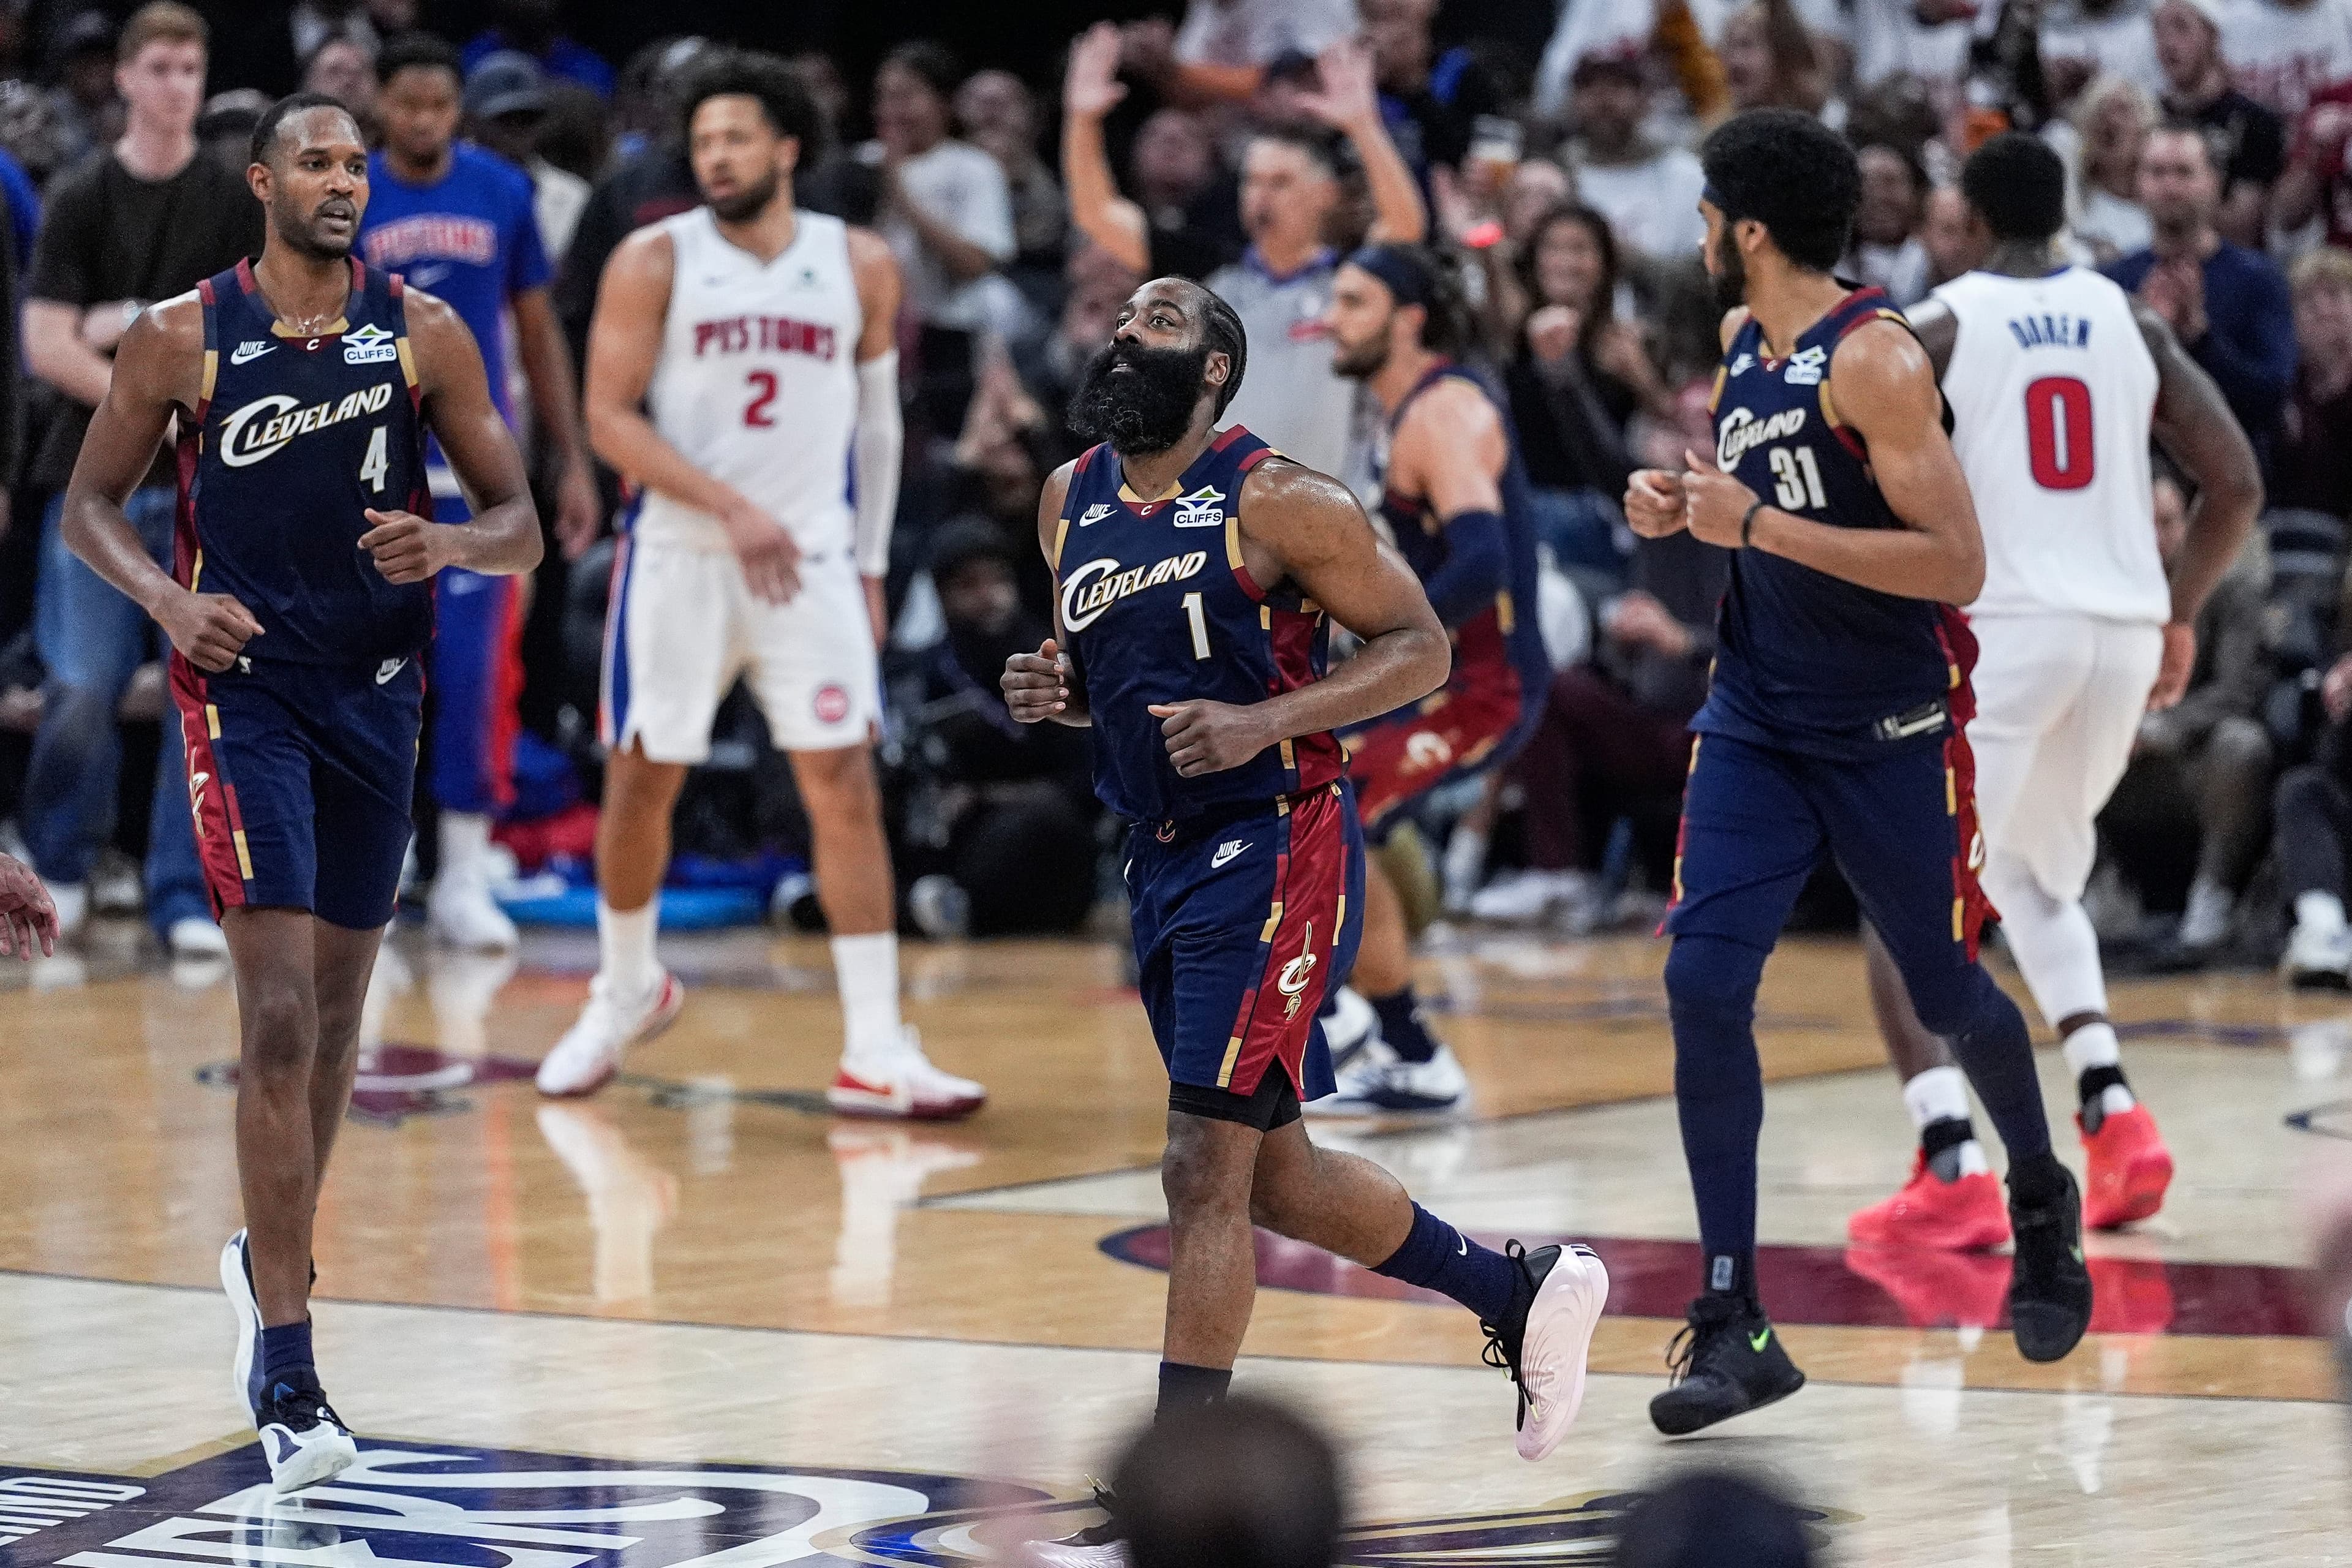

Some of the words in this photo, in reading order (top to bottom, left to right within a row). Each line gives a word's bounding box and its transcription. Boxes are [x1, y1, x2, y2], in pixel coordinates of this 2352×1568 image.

[238, 341, 266, 355] NIKE
[306, 338, 320, 351] C
[347, 349, 394, 360] CLIFFS
[744, 370, 778, 428] 2
[219, 382, 393, 467] CLEVELAND
[2025, 377, 2094, 489] 0
[360, 426, 390, 494] 4
[1768, 445, 1828, 510] 31
[1086, 503, 1110, 518] NIKE
[1140, 505, 1153, 516] C
[1177, 512, 1221, 524] CLIFFS
[1060, 551, 1207, 633] CLEVELAND
[1181, 592, 1212, 660] 1
[1216, 839, 1243, 858] NIKE
